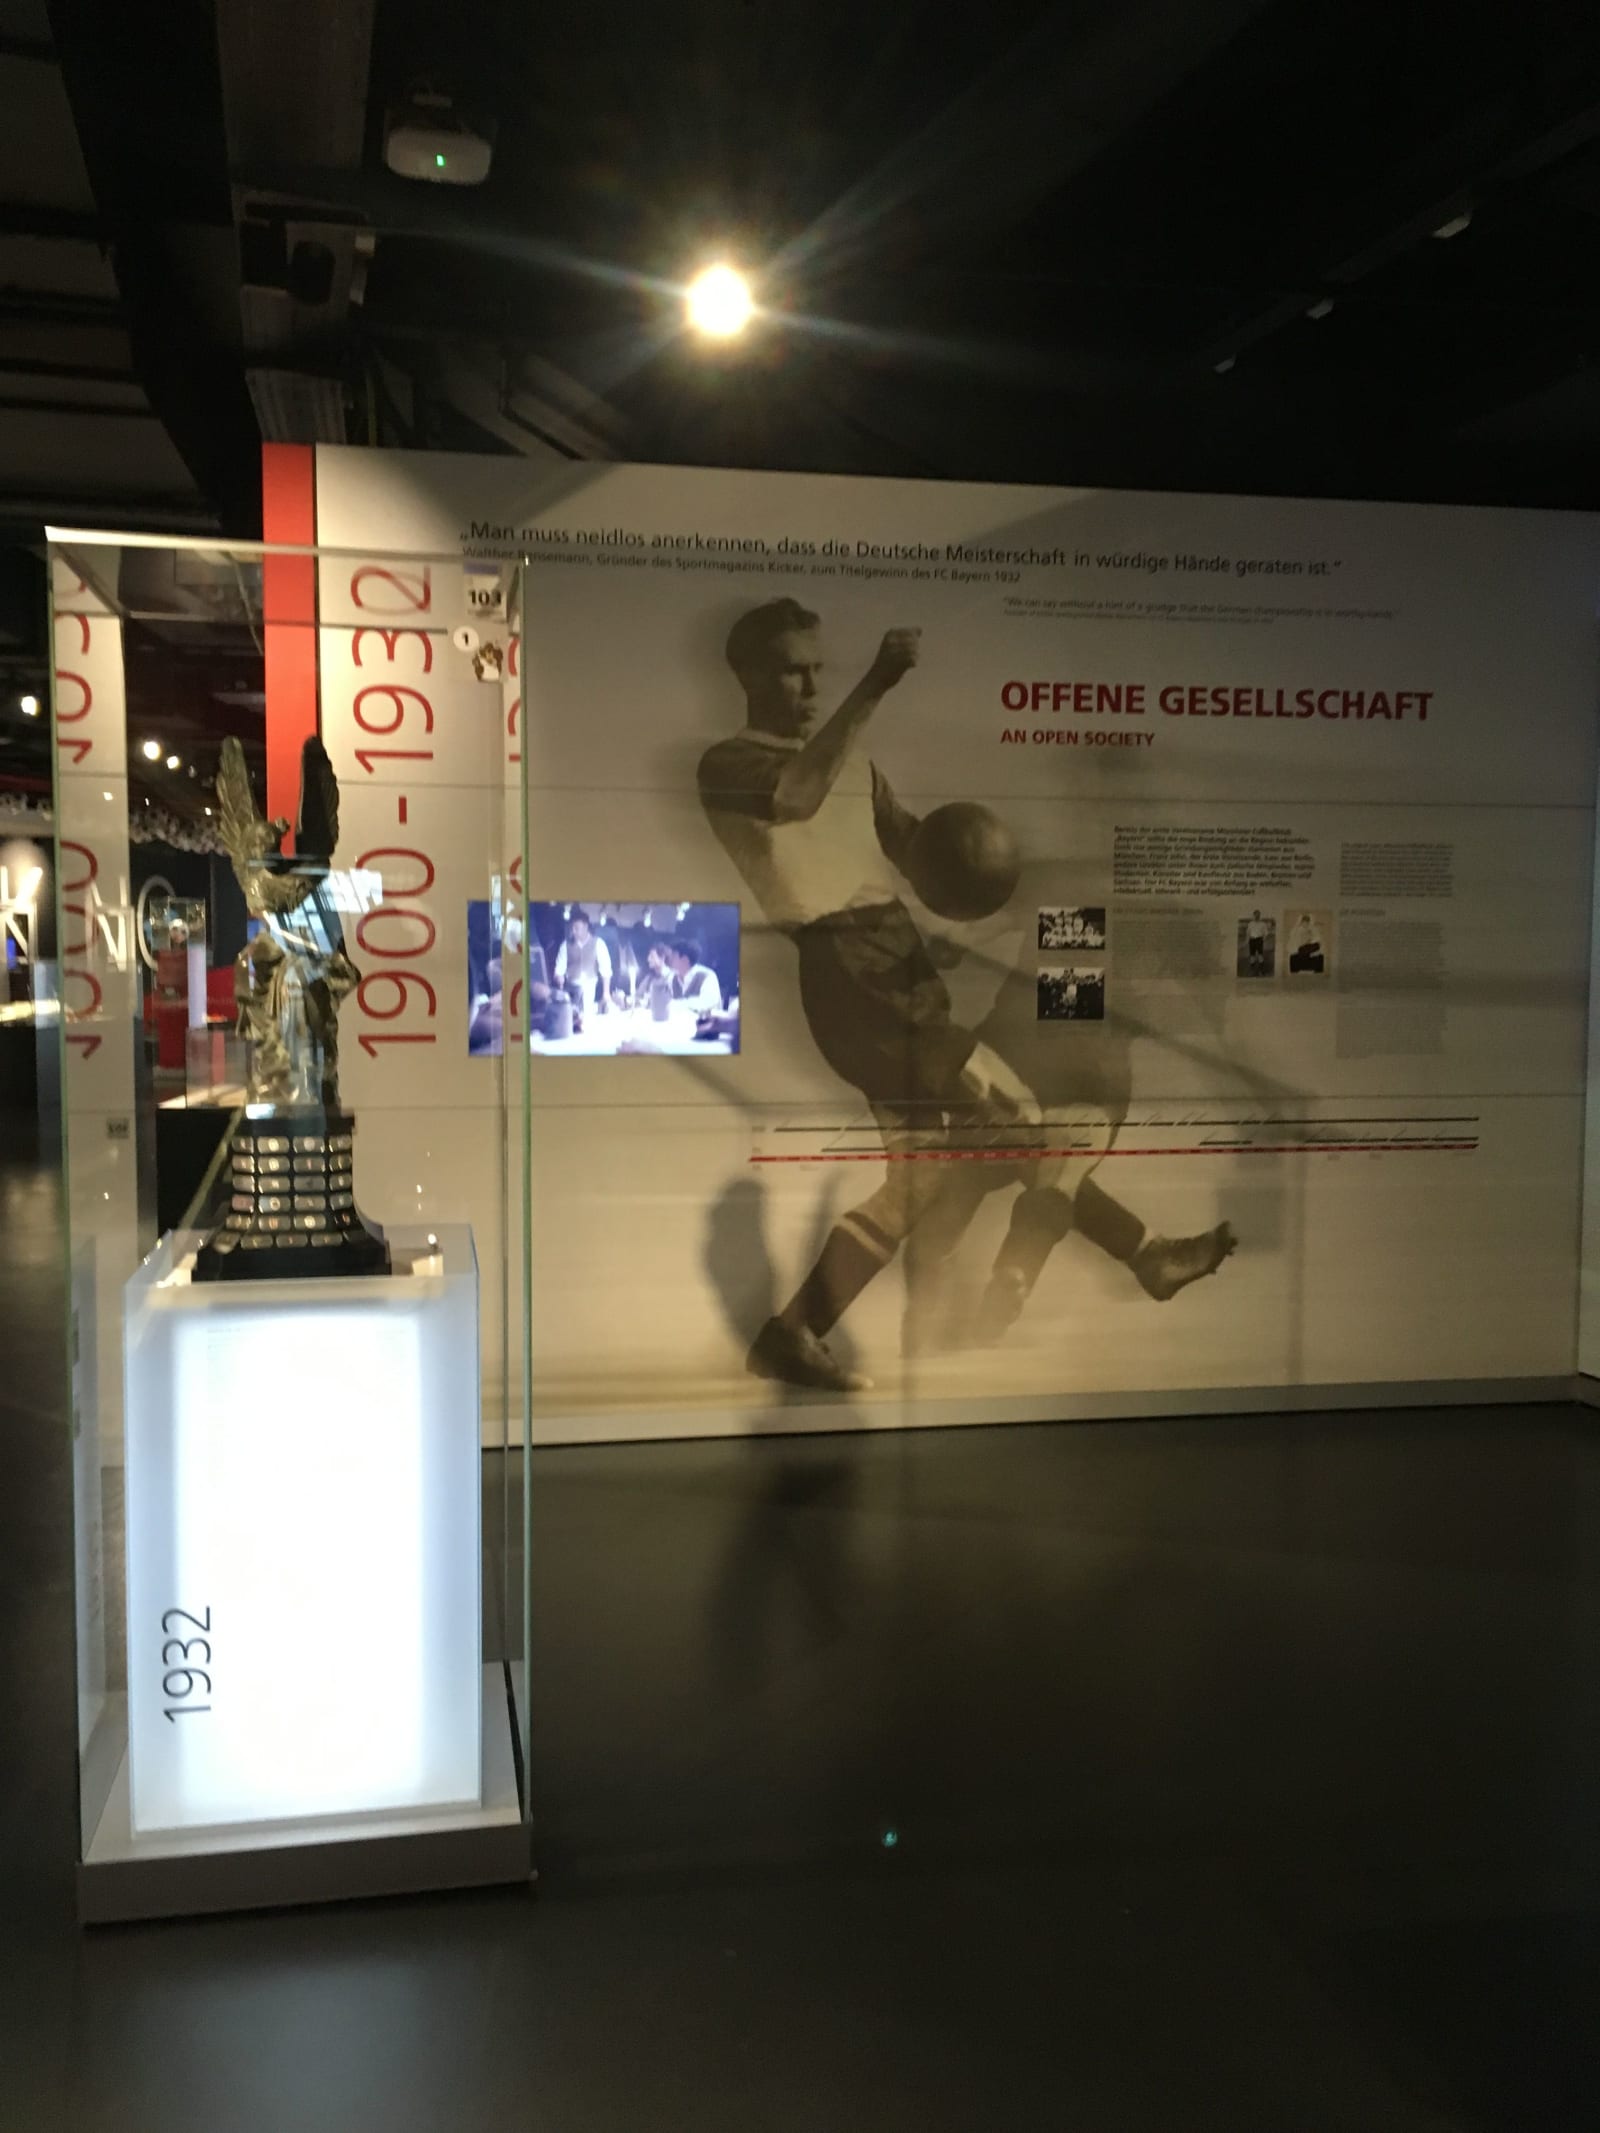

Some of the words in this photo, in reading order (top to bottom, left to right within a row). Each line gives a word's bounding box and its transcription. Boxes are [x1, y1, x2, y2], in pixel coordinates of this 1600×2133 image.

[522, 528, 569, 543] muss
[576, 527, 645, 548] neidlos
[652, 532, 770, 556] anerkennen,
[777, 536, 816, 556] dass
[822, 539, 850, 558] die
[857, 540, 939, 561] Deutsche
[946, 544, 1066, 567] Meisterschaft
[1074, 549, 1090, 567] in
[1095, 550, 1168, 574] würdige
[1174, 553, 1230, 574] Hände
[1235, 557, 1303, 578] geraten
[462, 632, 470, 647] 1
[350, 564, 435, 775] 1932
[1000, 680, 1147, 715] OFFENE
[1158, 684, 1435, 722] GESELLSCHAFT
[1000, 729, 1027, 745] AN
[1031, 730, 1080, 747] OPEN
[1083, 730, 1156, 748] SOCIETY
[354, 846, 438, 1060] 1900
[161, 1604, 212, 1724] 1932
